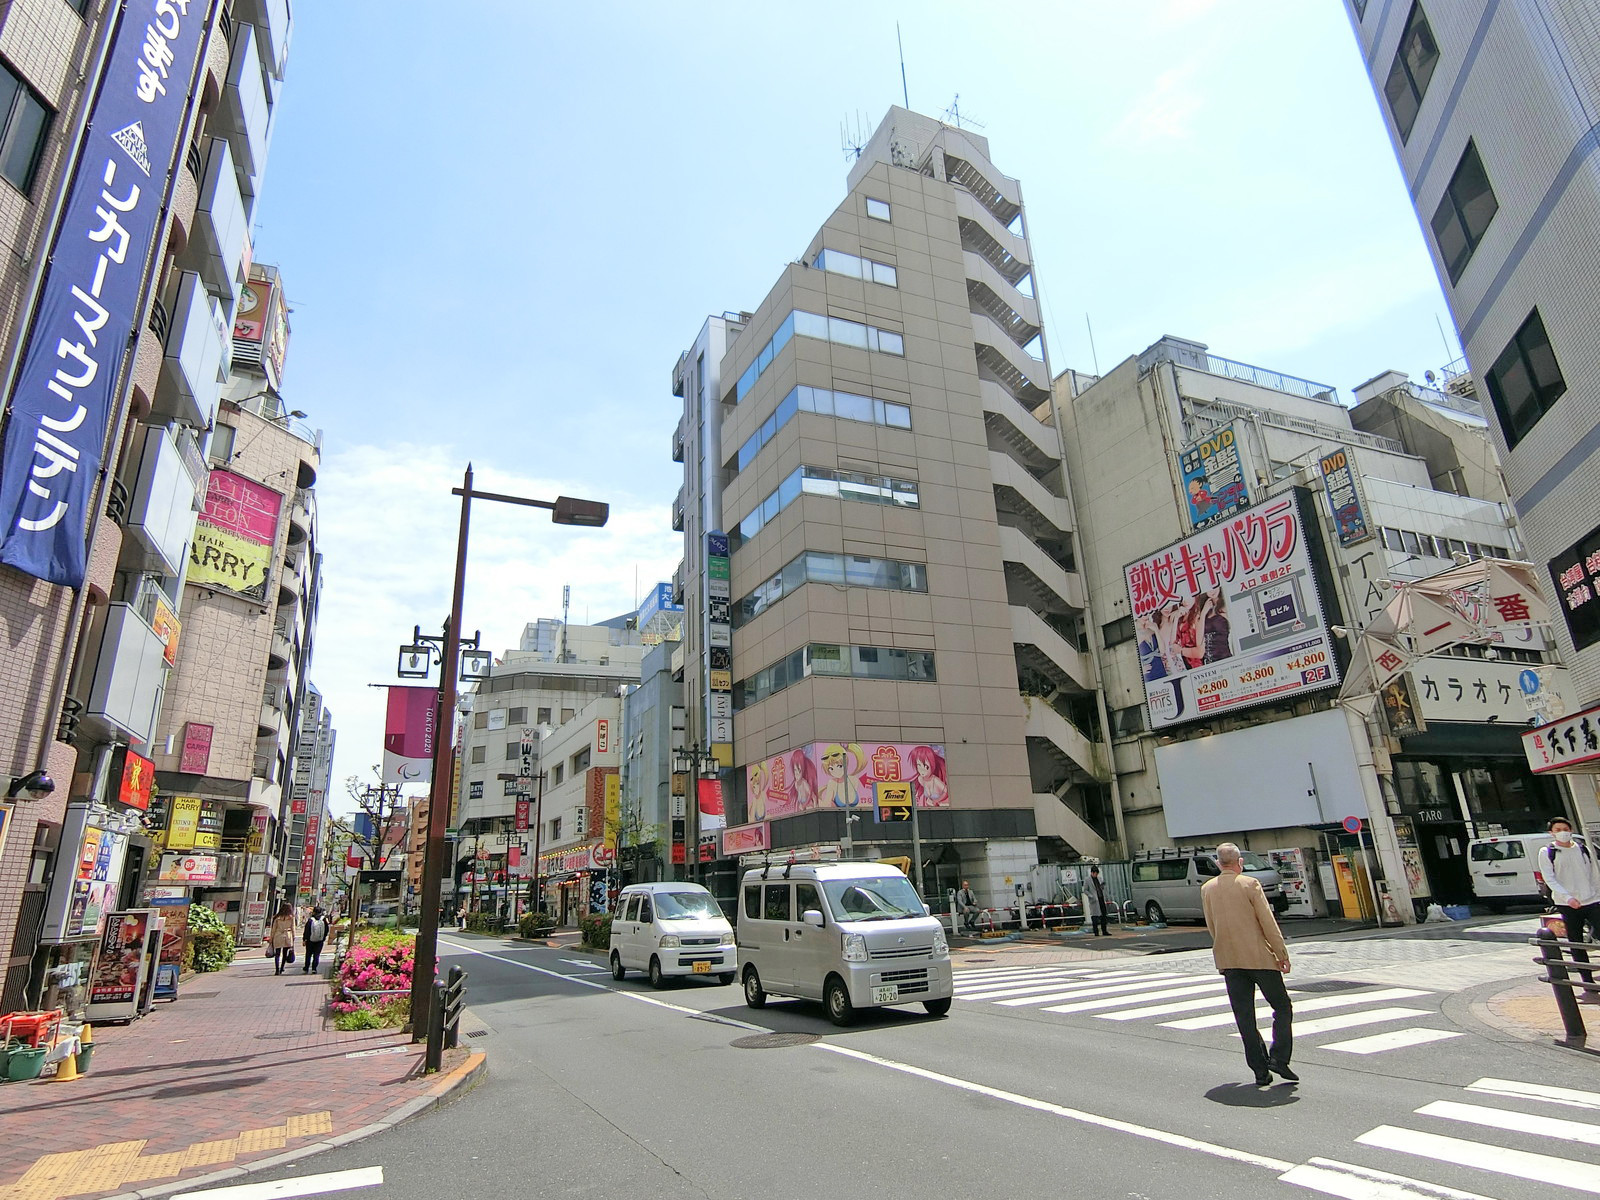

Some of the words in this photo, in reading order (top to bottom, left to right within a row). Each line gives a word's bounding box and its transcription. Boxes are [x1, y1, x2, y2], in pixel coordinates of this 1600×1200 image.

[115, 133, 151, 172] MOUNTAIN
[18, 158, 142, 532] リカーマウンテン
[1200, 428, 1235, 460] DVD
[1321, 451, 1347, 475] DVD
[198, 534, 225, 548] HAIR
[1240, 578, 1257, 592] 入口
[1260, 563, 1292, 584] 東側2F
[1286, 651, 1326, 671] ¥4,800
[1193, 669, 1218, 681] SYSTEM
[1239, 665, 1274, 684] ¥3,800
[1305, 666, 1326, 684] 2F
[1197, 678, 1229, 695] ¥2,800
[1420, 674, 1512, 705] カラオケ
[1162, 675, 1188, 721] J
[425, 707, 434, 733] TOKYO
[717, 696, 726, 742] IMPACT
[424, 733, 432, 753] 2020
[772, 756, 785, 791] 萌
[872, 745, 902, 782] 萌
[714, 780, 724, 807] TOKYO
[883, 789, 907, 800] Times
[175, 802, 200, 812] CARRY
[881, 807, 891, 821] P
[1418, 810, 1442, 822] TARO
[878, 991, 898, 1002] 20-20
